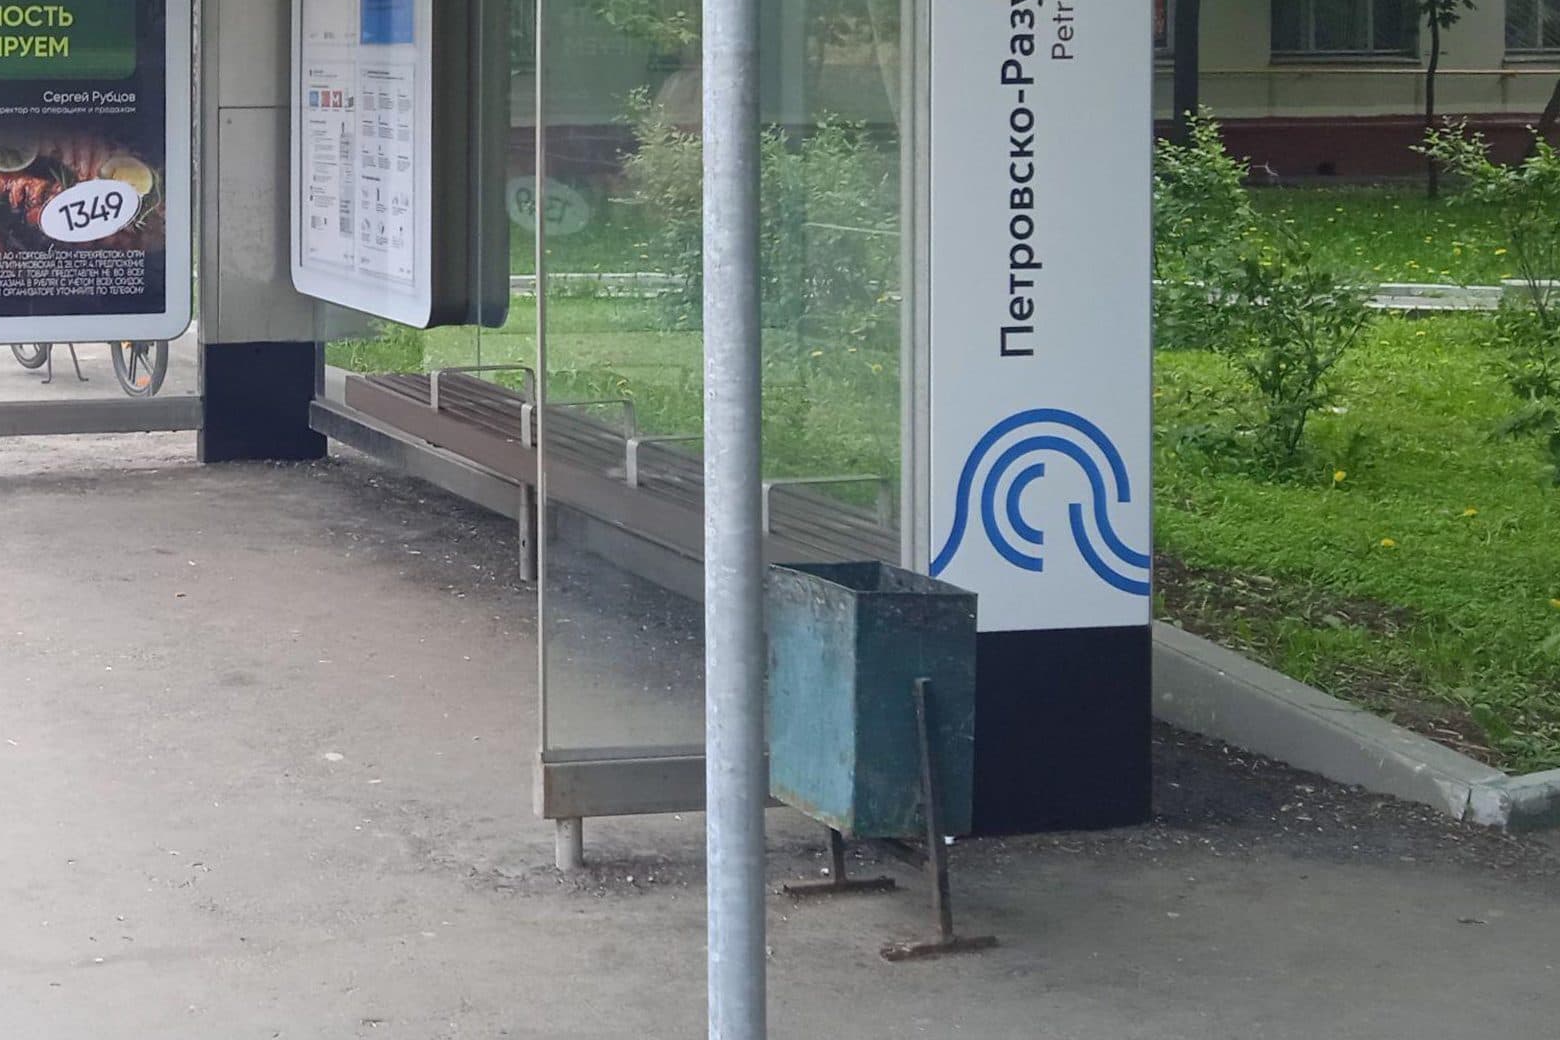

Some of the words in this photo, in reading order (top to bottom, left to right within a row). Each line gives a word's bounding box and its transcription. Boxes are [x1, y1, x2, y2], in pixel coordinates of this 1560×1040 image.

[43, 91, 89, 104] Сергей
[92, 91, 136, 105] Рубцов
[59, 191, 123, 231] 1349
